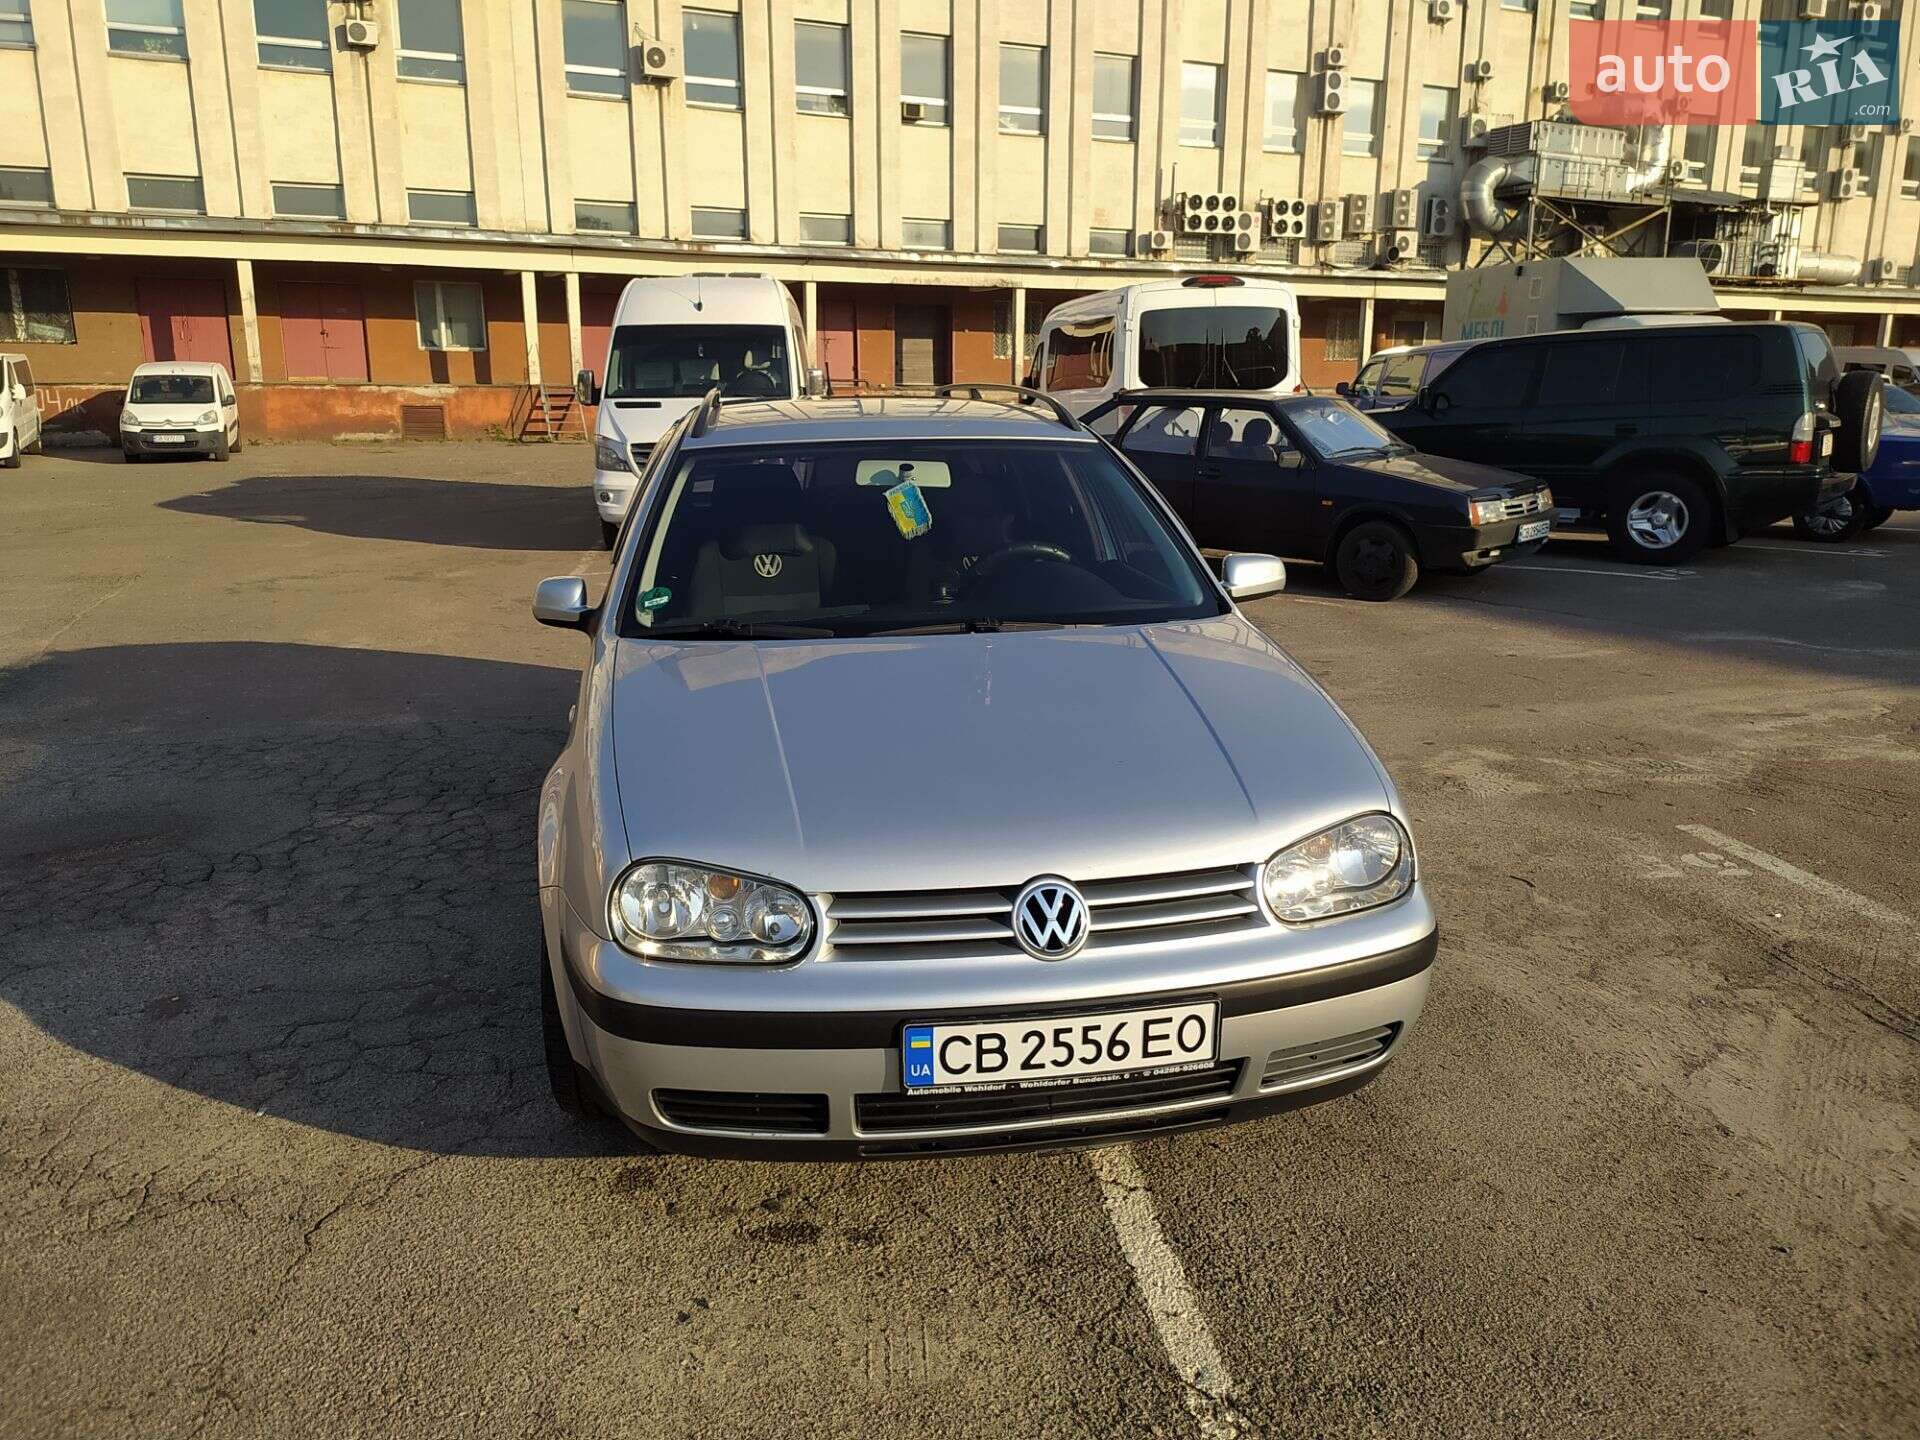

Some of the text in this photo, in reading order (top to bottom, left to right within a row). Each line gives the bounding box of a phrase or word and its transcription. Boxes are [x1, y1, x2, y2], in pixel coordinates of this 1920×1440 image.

[1016, 883, 1086, 955] VW
[940, 1014, 1206, 1075] CB 2556 EO
[911, 1064, 931, 1077] UA
[907, 1085, 962, 1096] Automobile
